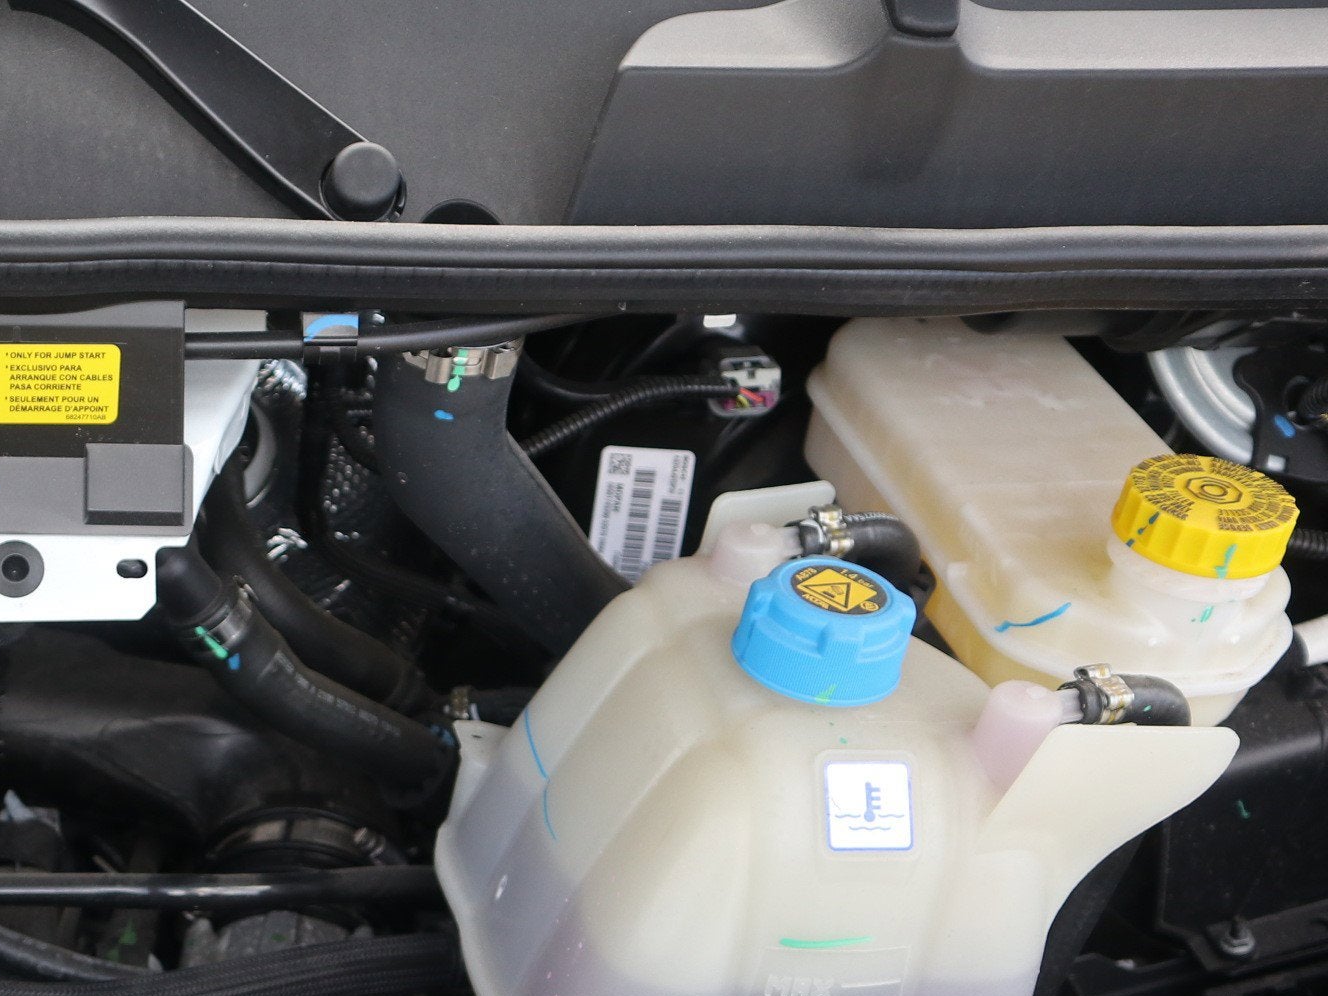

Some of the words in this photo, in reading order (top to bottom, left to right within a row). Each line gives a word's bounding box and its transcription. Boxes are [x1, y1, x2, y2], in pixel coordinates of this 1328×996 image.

[9, 374, 58, 382] ARRANQUE
[9, 383, 34, 391] PASA
[9, 403, 63, 412] DÉMARRAGE
